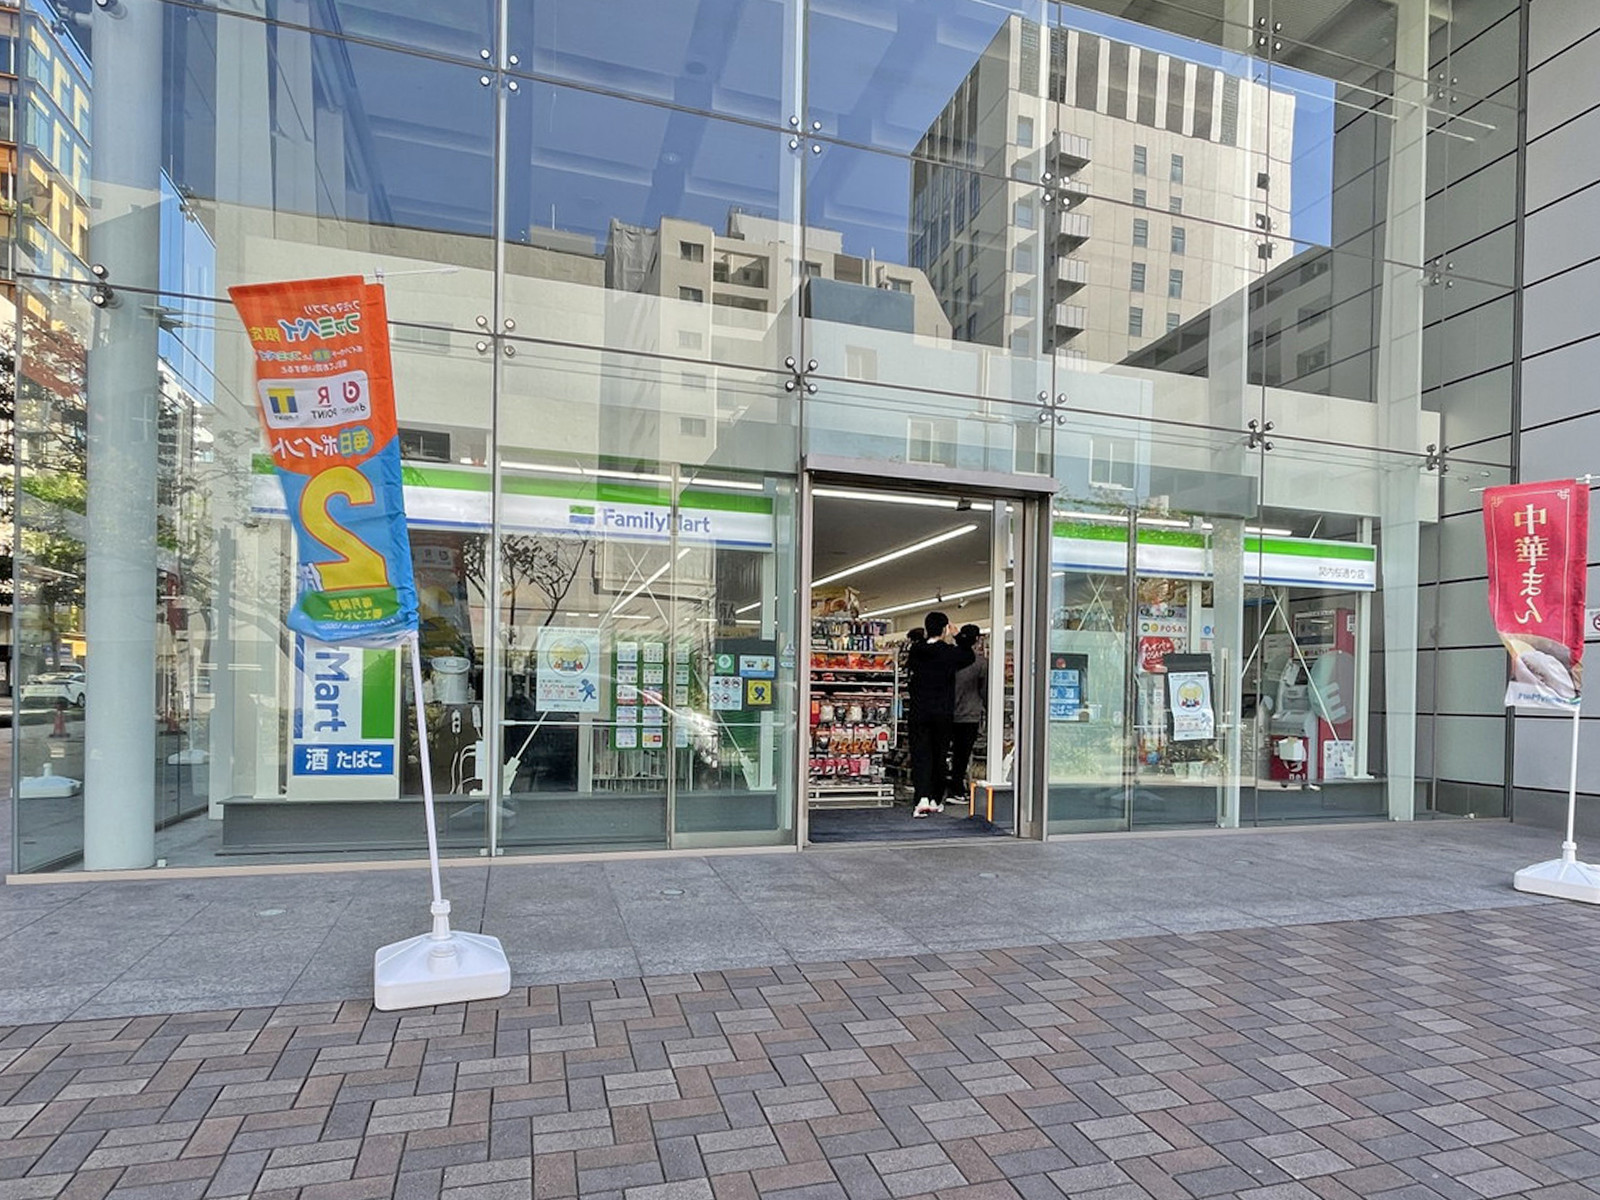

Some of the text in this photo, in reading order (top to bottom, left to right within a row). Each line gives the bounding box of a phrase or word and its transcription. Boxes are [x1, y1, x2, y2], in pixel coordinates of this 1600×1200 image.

[1512, 503, 1550, 624] 中華まん
[305, 748, 382, 771] 酒 たばこ
